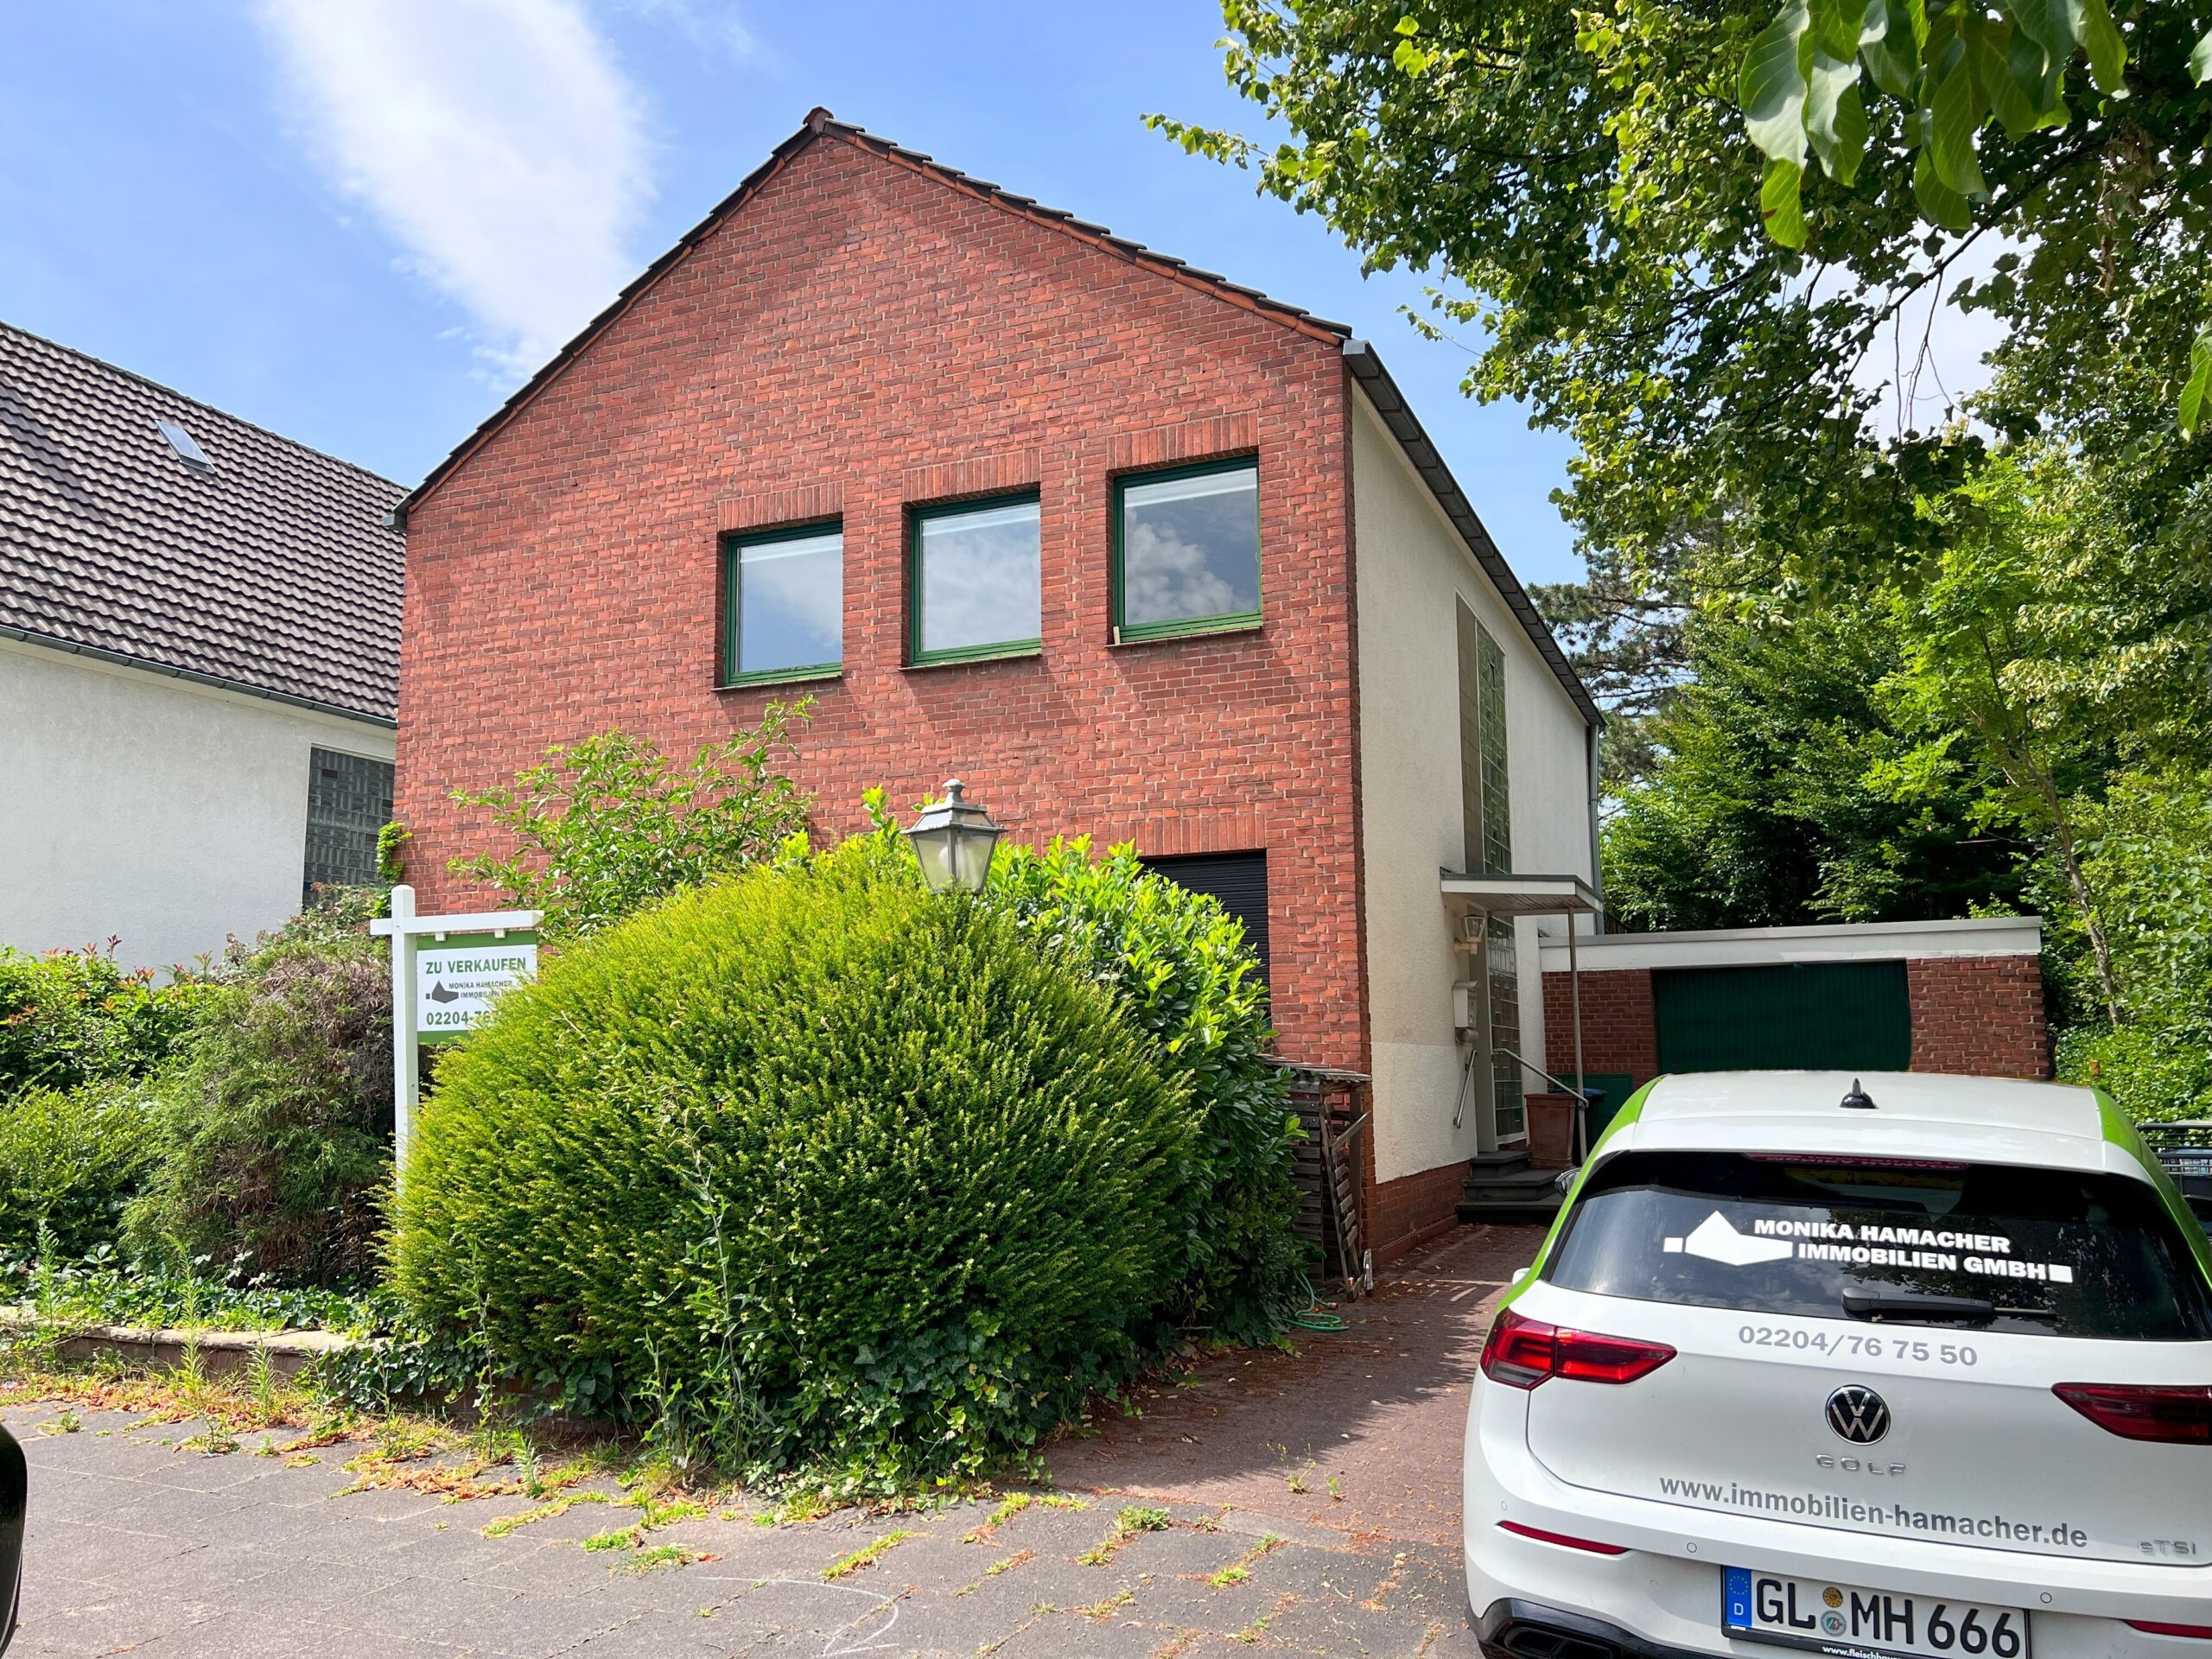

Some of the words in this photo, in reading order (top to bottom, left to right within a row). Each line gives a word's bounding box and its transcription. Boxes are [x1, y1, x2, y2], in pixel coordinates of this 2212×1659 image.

[426, 961, 442, 975] ZU
[448, 957, 526, 973] VERKAUFEN
[1753, 1219, 1857, 1241] MONIKA
[1860, 1225, 2011, 1254] HAMACHER
[1798, 1244, 1956, 1271] IMMOBILIEN
[1962, 1255, 2047, 1281] GMBH
[1738, 1325, 1883, 1357] 02204/76
[1892, 1339, 1930, 1362] 75
[1940, 1344, 1978, 1366] 50
[1815, 1453, 1906, 1477] GOLF
[1659, 1477, 2088, 1548] www.immobilien-hamacher.de
[1733, 1602, 1744, 1616] D
[1757, 1578, 1816, 1630] GL
[1851, 1591, 1915, 1645] MH
[1927, 1603, 2020, 1659] 666
